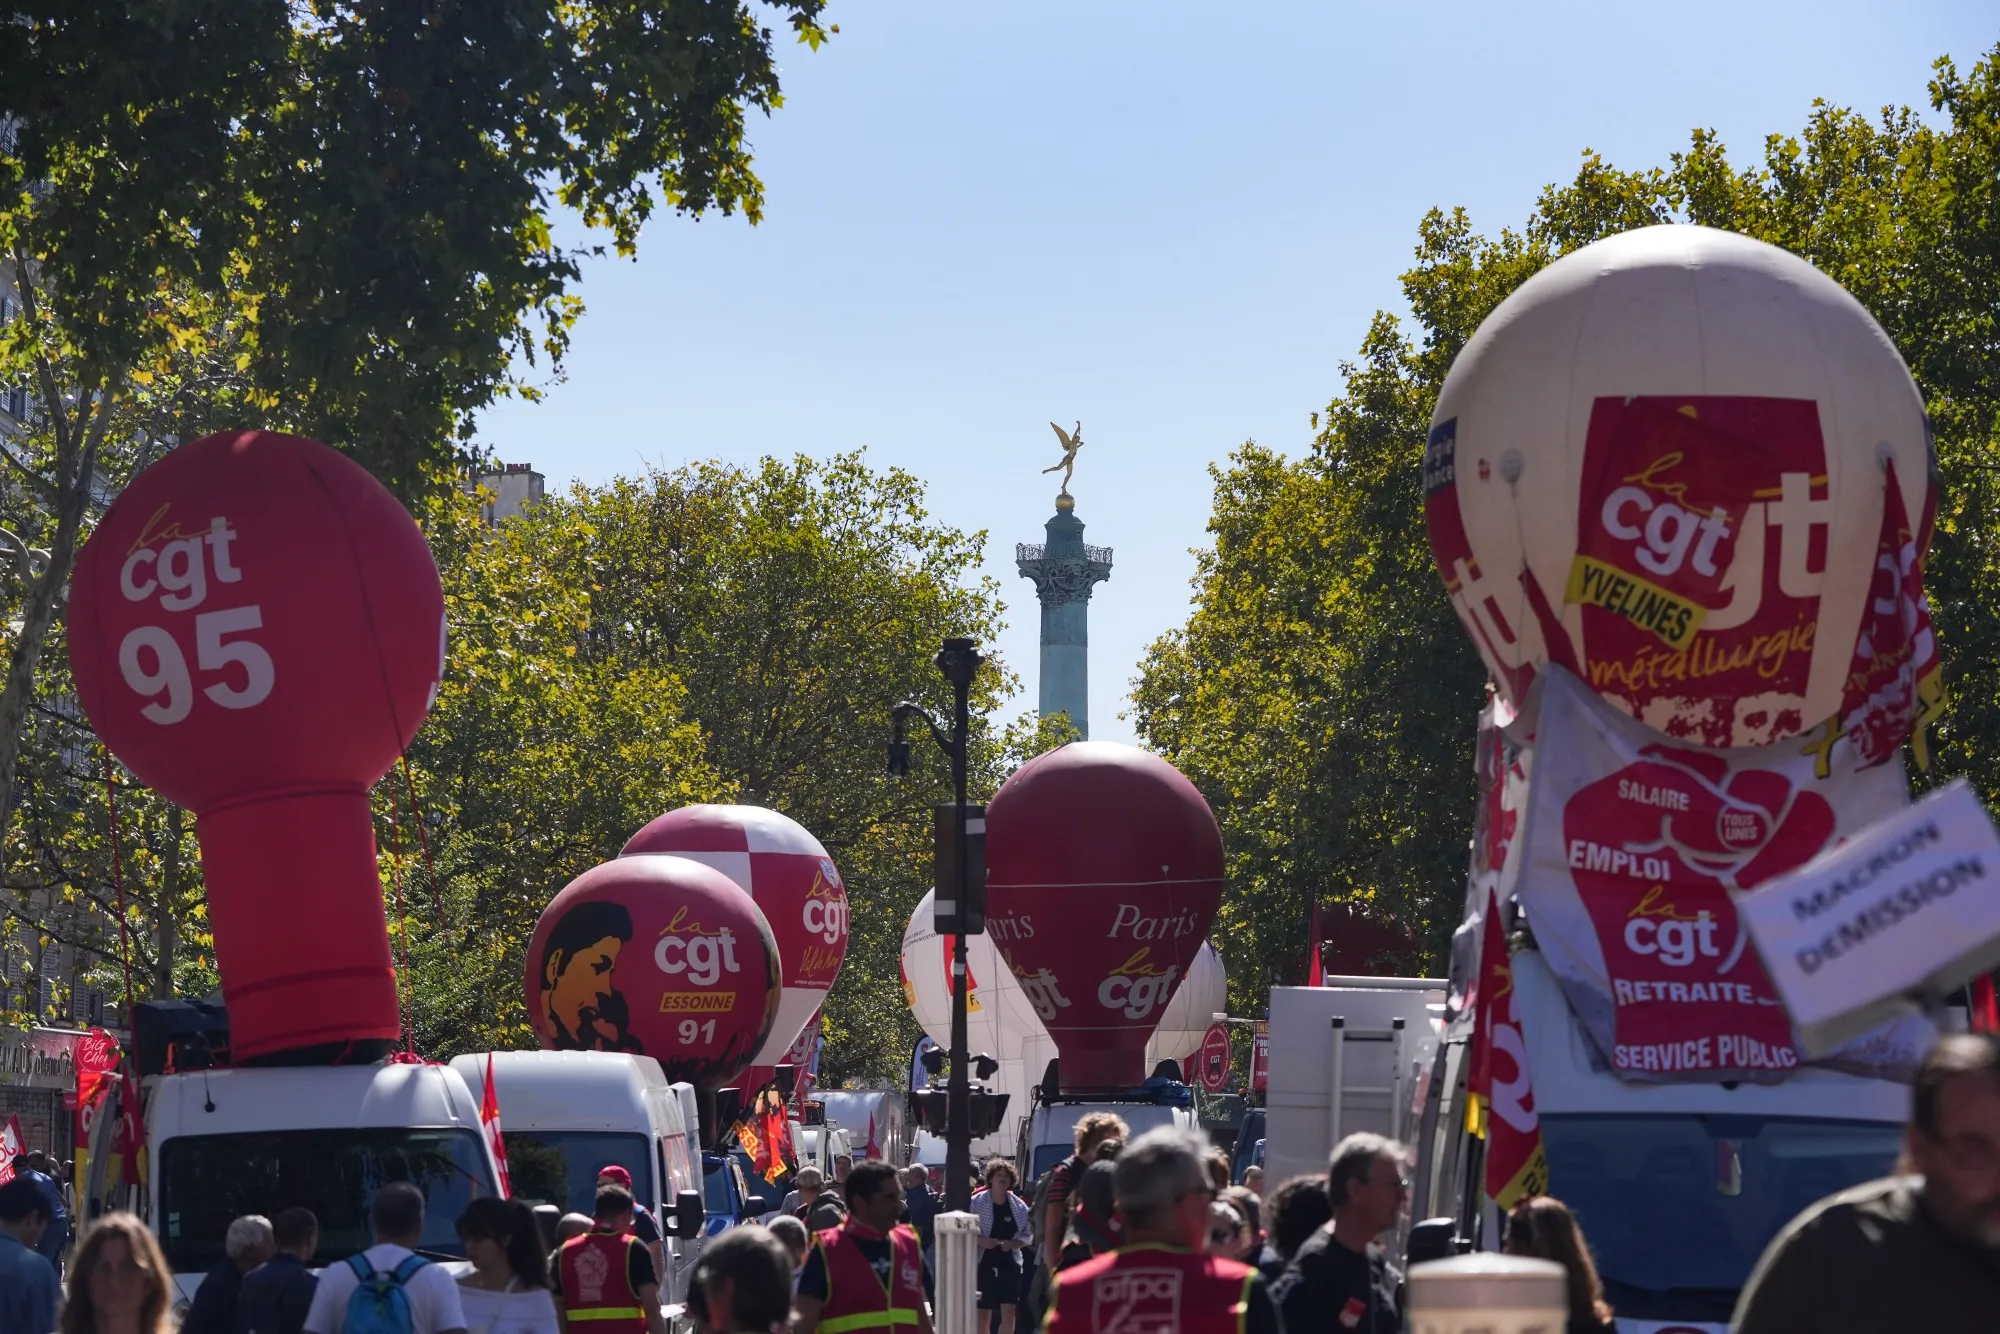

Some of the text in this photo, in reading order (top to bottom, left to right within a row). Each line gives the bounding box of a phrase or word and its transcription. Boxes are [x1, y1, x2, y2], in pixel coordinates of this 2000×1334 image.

[1622, 451, 1725, 521] la
[127, 502, 222, 556] la
[1601, 486, 1731, 578] cgt
[119, 515, 242, 612] cgt
[1581, 563, 1693, 643] YVELINES
[118, 604, 276, 725] 95
[1588, 612, 1817, 692] métallurgie
[1617, 778, 1690, 812] SALAIRE
[1723, 814, 1755, 827] TOUS
[1724, 826, 1758, 841] UNIS
[1568, 839, 1671, 882] EMPLOI
[1791, 820, 1943, 921] MACRON
[805, 870, 840, 900] la
[1627, 884, 1709, 918] la
[659, 905, 727, 936] la
[802, 893, 849, 945] cgt
[985, 909, 1035, 941] aris
[1106, 903, 1199, 940] Paris
[1794, 857, 1986, 976] DEMISSION
[654, 926, 741, 986] cgt
[1623, 909, 1721, 967] cgt
[1108, 945, 1163, 976] la
[662, 995, 733, 1010] ESSONNE
[1015, 967, 1072, 1021] gt
[1097, 964, 1179, 1020] cgt
[677, 1018, 717, 1045] 91
[1256, 1023, 1269, 1033] ENS
[1210, 1054, 1221, 1064] CGT
[1260, 1048, 1269, 1057] EX
[1613, 1034, 1798, 1071] SERVICE PUBLIC
